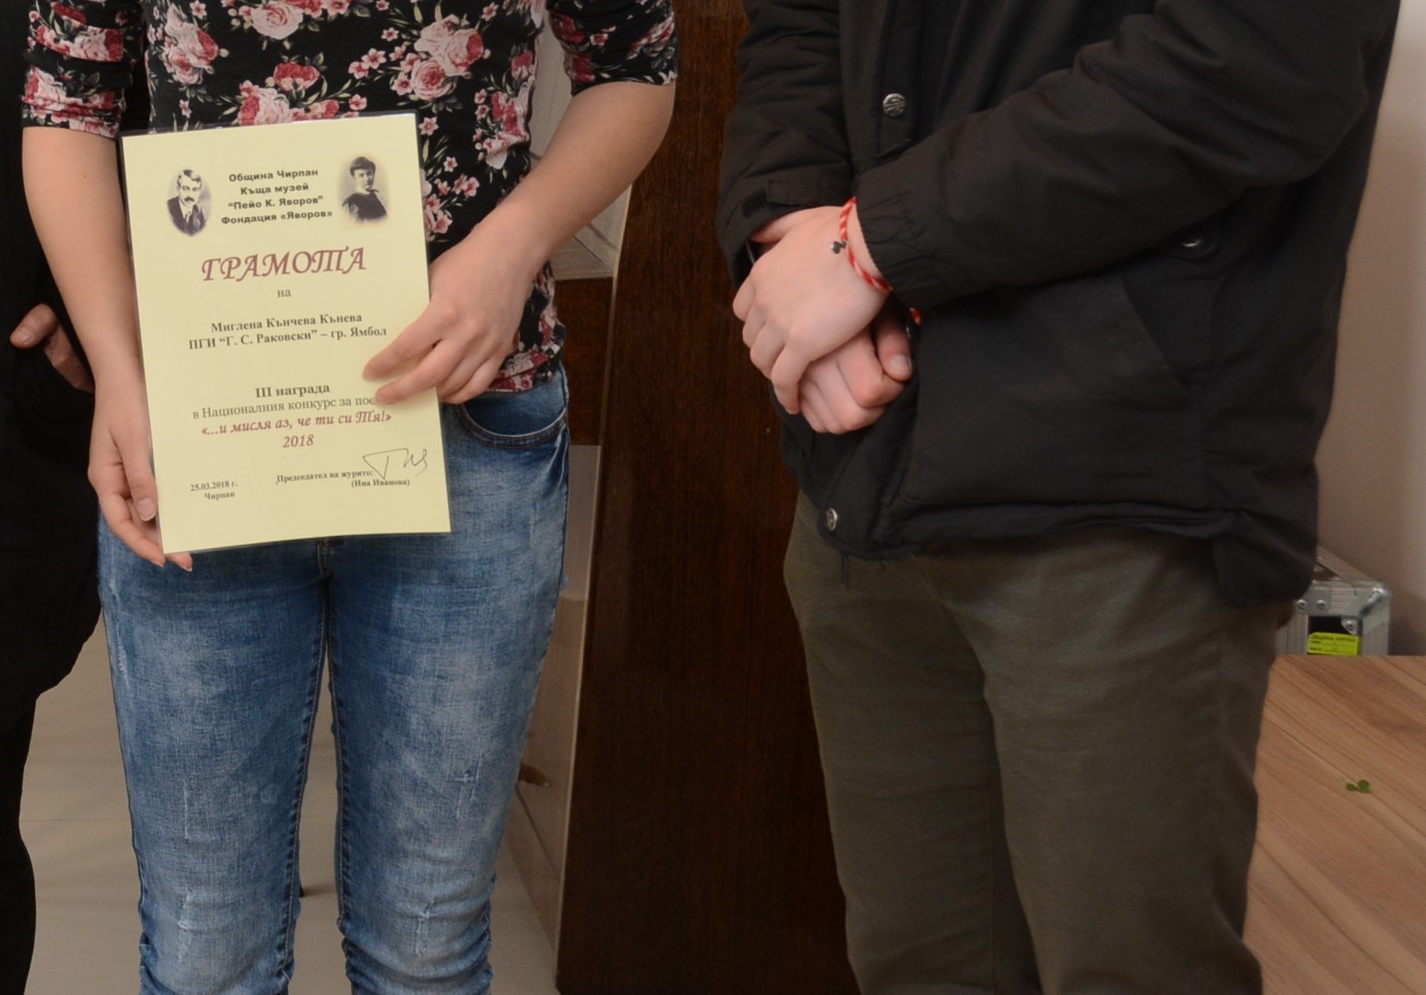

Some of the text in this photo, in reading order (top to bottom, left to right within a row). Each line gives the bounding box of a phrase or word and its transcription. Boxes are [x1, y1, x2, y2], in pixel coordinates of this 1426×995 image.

[229, 169, 318, 182] Община Чирпан
[240, 183, 309, 195] Къща музей
[265, 199, 276, 207] К.
[221, 214, 277, 225] Фондация
[201, 246, 367, 282] ГРАМОТА
[277, 288, 291, 298] на
[211, 314, 362, 333] Миглена Кънчева Кънева
[189, 337, 216, 350] ПГИ
[240, 335, 254, 345] С.
[331, 330, 347, 340] гр.
[350, 326, 387, 337] Ямбол
[255, 385, 330, 399] III награда
[192, 411, 199, 419] в
[202, 402, 285, 419] Националния
[288, 398, 337, 411] конкурс
[339, 398, 352, 407] за
[230, 421, 272, 433] мисля
[275, 418, 293, 430] аз,
[297, 417, 312, 427] че
[315, 416, 334, 425] ти
[338, 414, 352, 423] си
[282, 434, 314, 448] 2018
[277, 472, 328, 484] Председател
[190, 480, 230, 492] 25.03.2018
[204, 491, 235, 501] Чирпан
